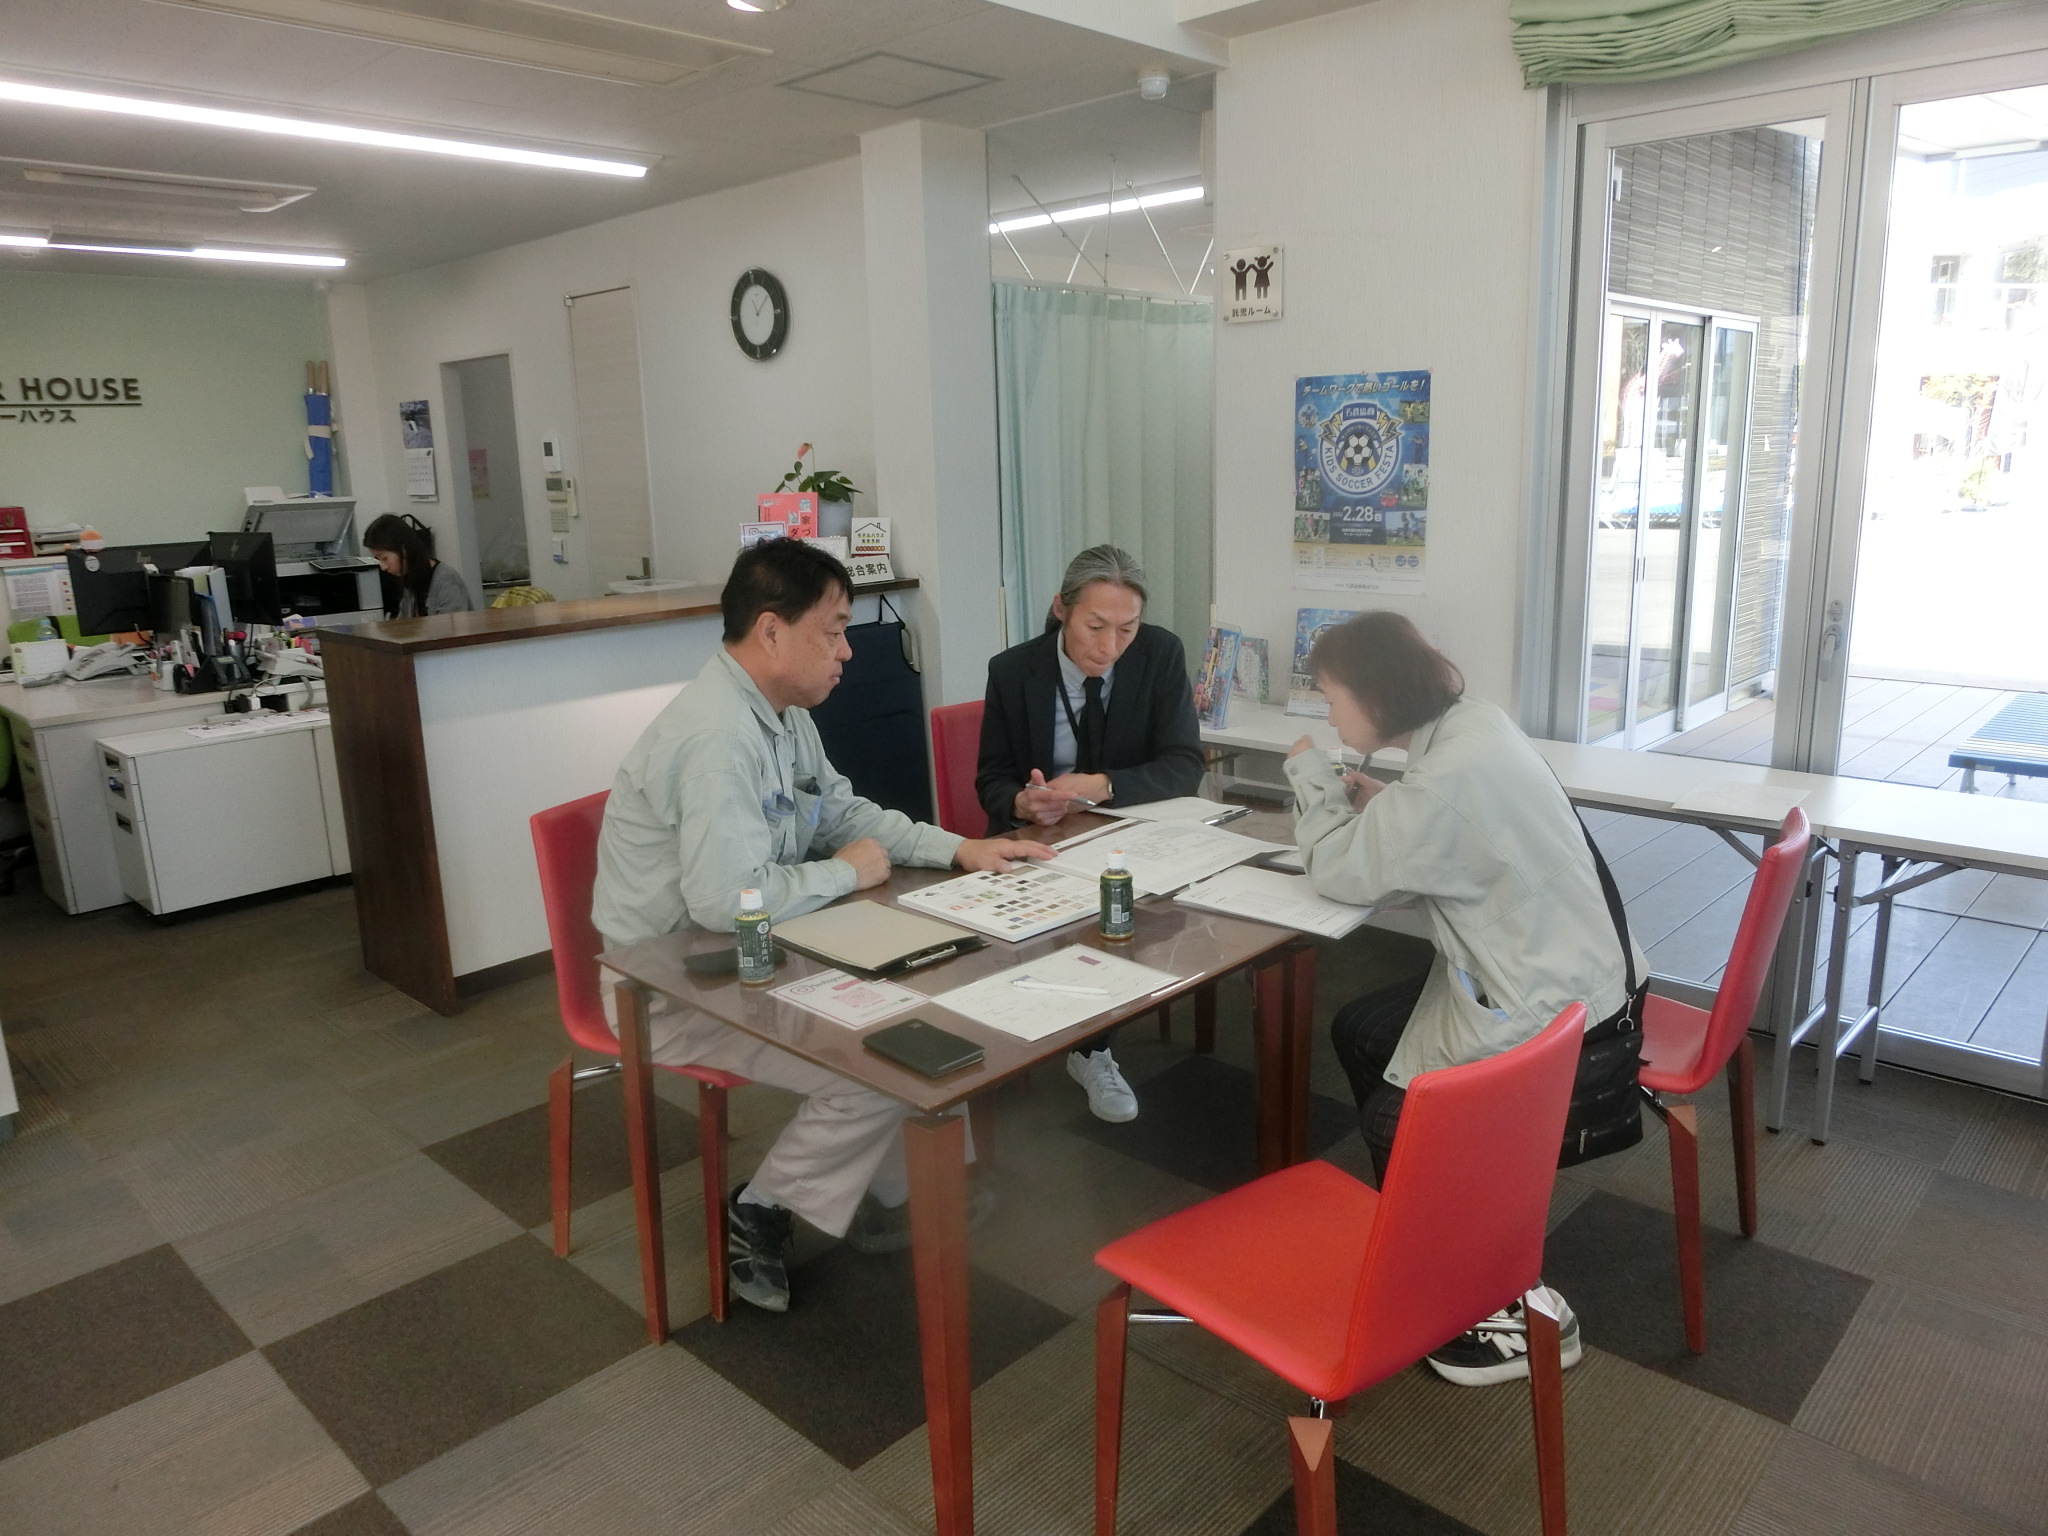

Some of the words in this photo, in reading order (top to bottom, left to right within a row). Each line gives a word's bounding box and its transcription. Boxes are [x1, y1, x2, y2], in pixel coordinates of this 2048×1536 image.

[1232, 305, 1271, 318] 託児ルーム
[20, 377, 141, 401] HOUSE
[1324, 447, 1337, 473] KIDS
[1335, 473, 1374, 489] SOCCER
[1374, 445, 1394, 480] FESTA
[1343, 506, 1374, 522] 2.28
